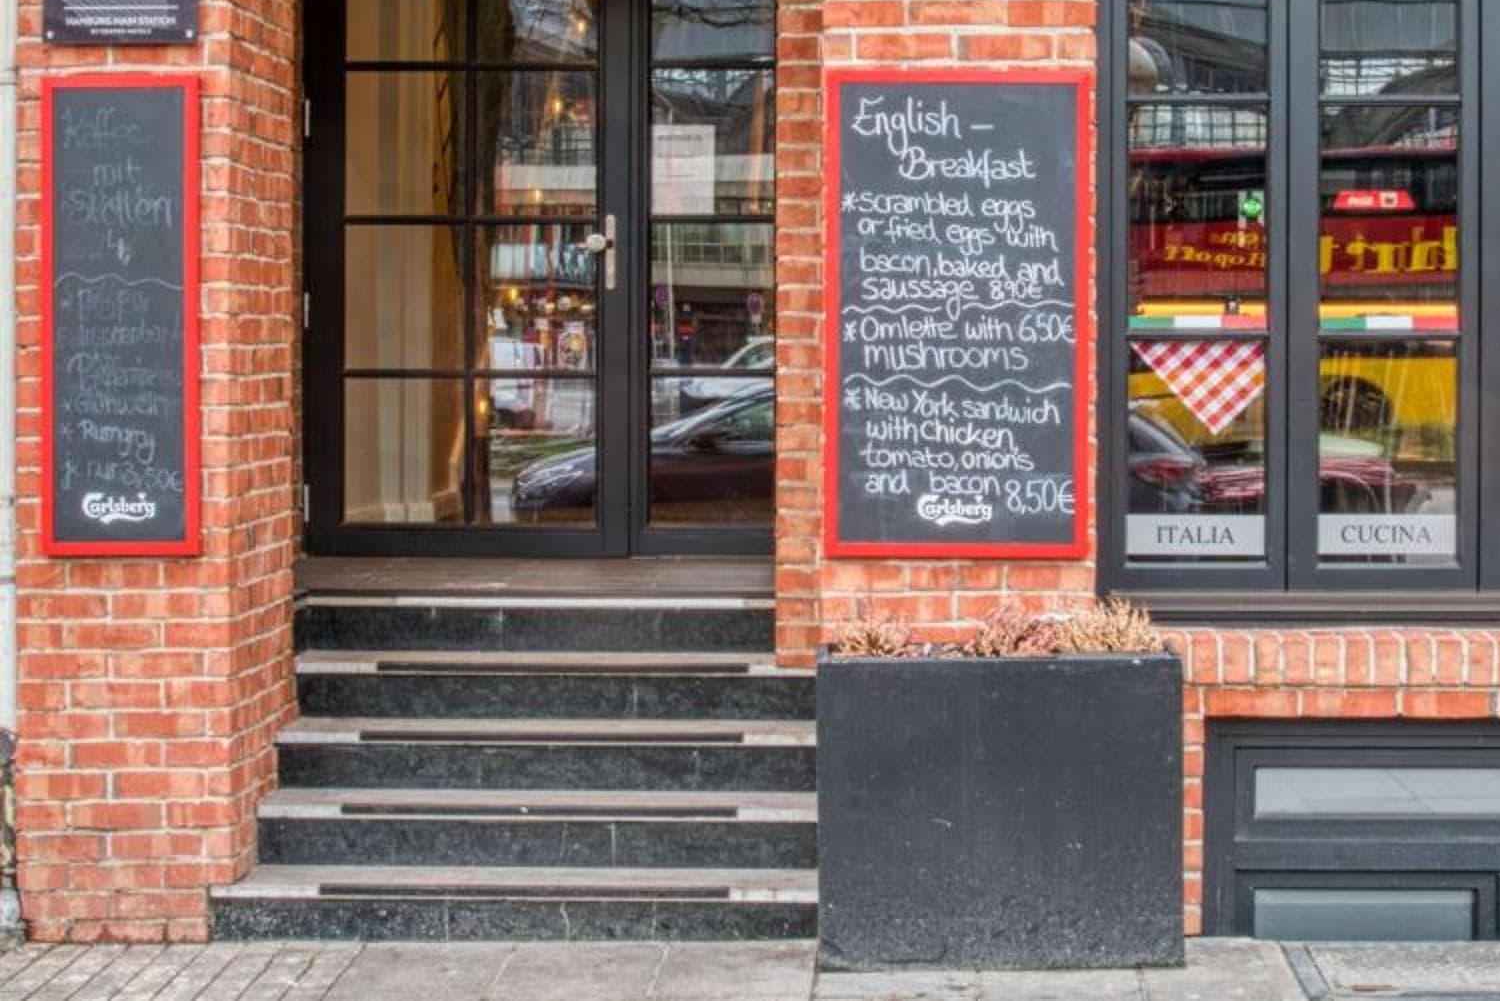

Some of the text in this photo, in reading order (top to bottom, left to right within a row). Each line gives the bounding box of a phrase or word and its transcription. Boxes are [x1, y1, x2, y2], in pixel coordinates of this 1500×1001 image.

[899, 146, 1036, 188] Breakfast
[981, 198, 1037, 233] eggs
[857, 216, 1060, 256] or fried eggs with
[938, 252, 1011, 281] baked
[1017, 257, 1065, 287] and
[965, 317, 1014, 342] with
[864, 342, 1029, 371] mushrooms
[864, 388, 1061, 425] New York sandwich
[866, 417, 918, 443] with
[864, 471, 911, 495] and
[929, 471, 1002, 496] bacon
[82, 491, 156, 525] Carlsberg
[917, 493, 993, 526] Carlsberg
[1155, 524, 1236, 545] ITALIA
[1340, 524, 1433, 545] CUCINA
